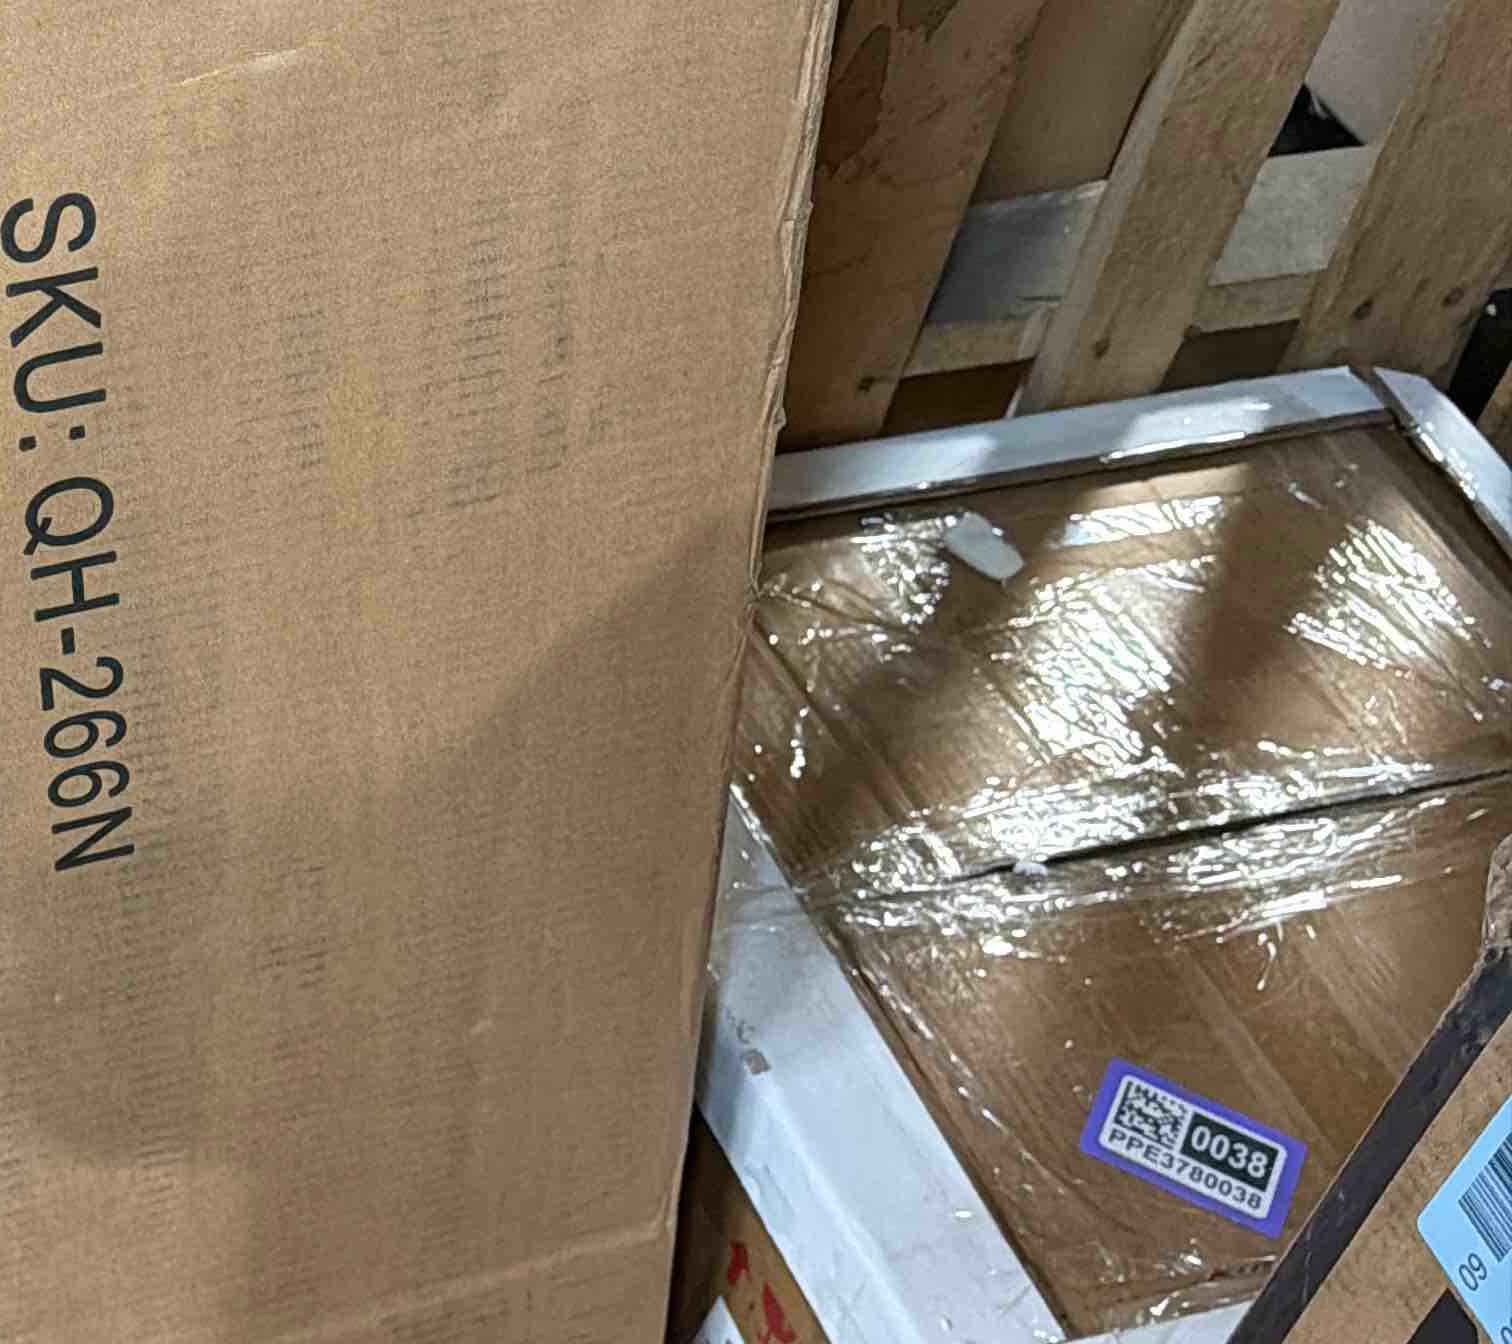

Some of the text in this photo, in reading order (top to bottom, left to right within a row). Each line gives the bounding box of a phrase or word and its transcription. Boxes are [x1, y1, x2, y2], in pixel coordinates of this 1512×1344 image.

[0, 192, 135, 872] SKU: QH-266N
[1107, 1128, 1262, 1210] PPE3780038
[1191, 1125, 1269, 1178] 0038
